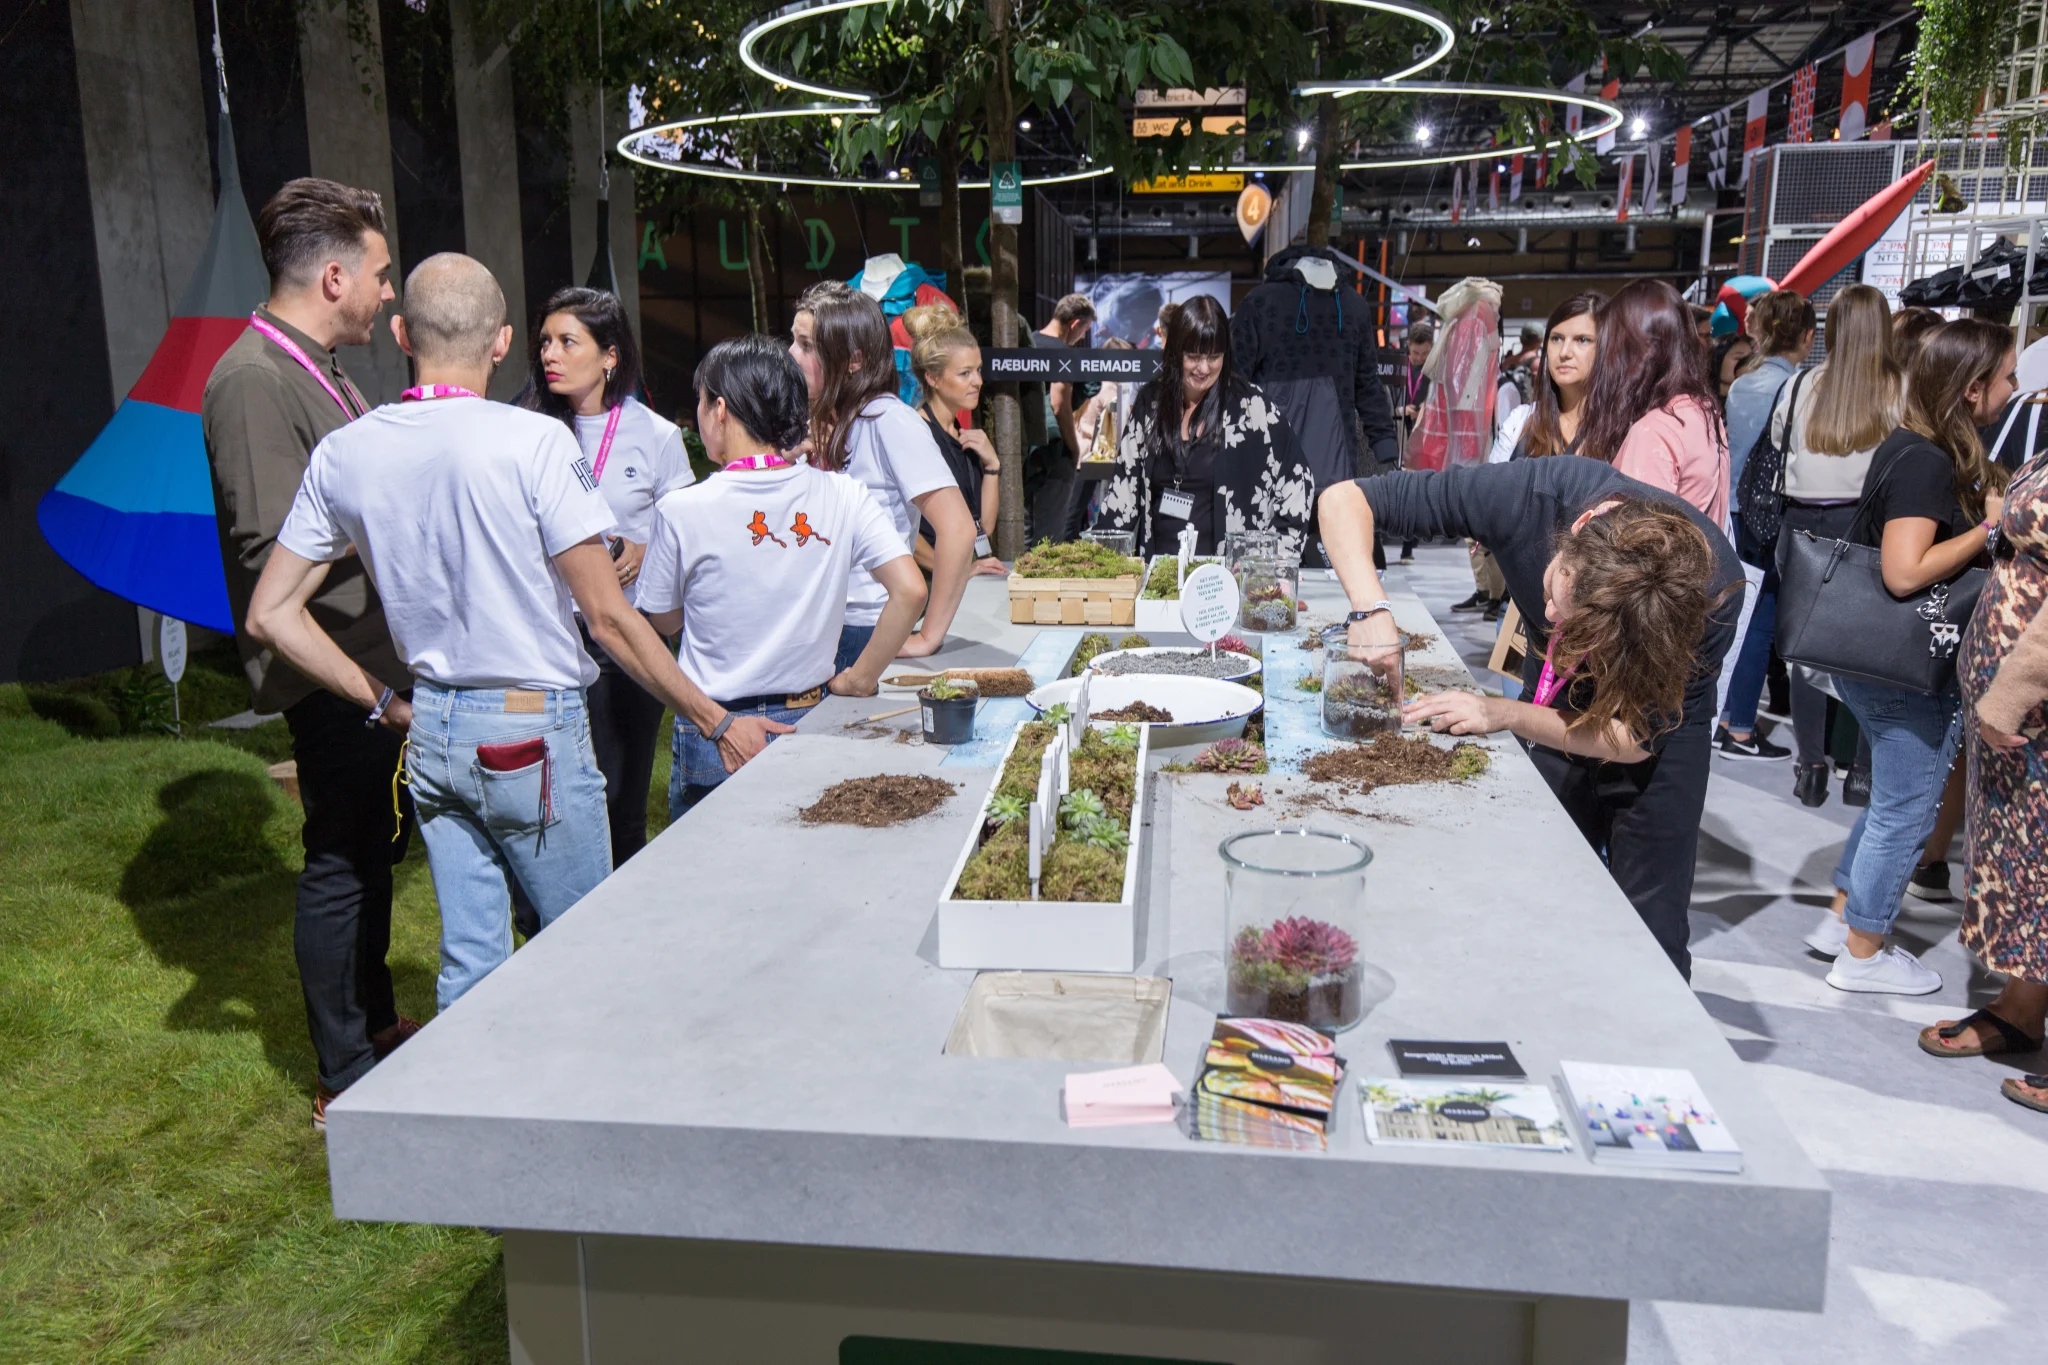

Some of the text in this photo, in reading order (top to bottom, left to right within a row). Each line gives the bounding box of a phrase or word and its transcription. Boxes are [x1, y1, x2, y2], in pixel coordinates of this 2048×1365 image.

[1152, 123, 1169, 132] WC
[1188, 180, 1213, 189] Drink
[1247, 195, 1260, 220] 4
[991, 358, 1050, 372] RÆBURN
[1080, 359, 1141, 373] REMADE
